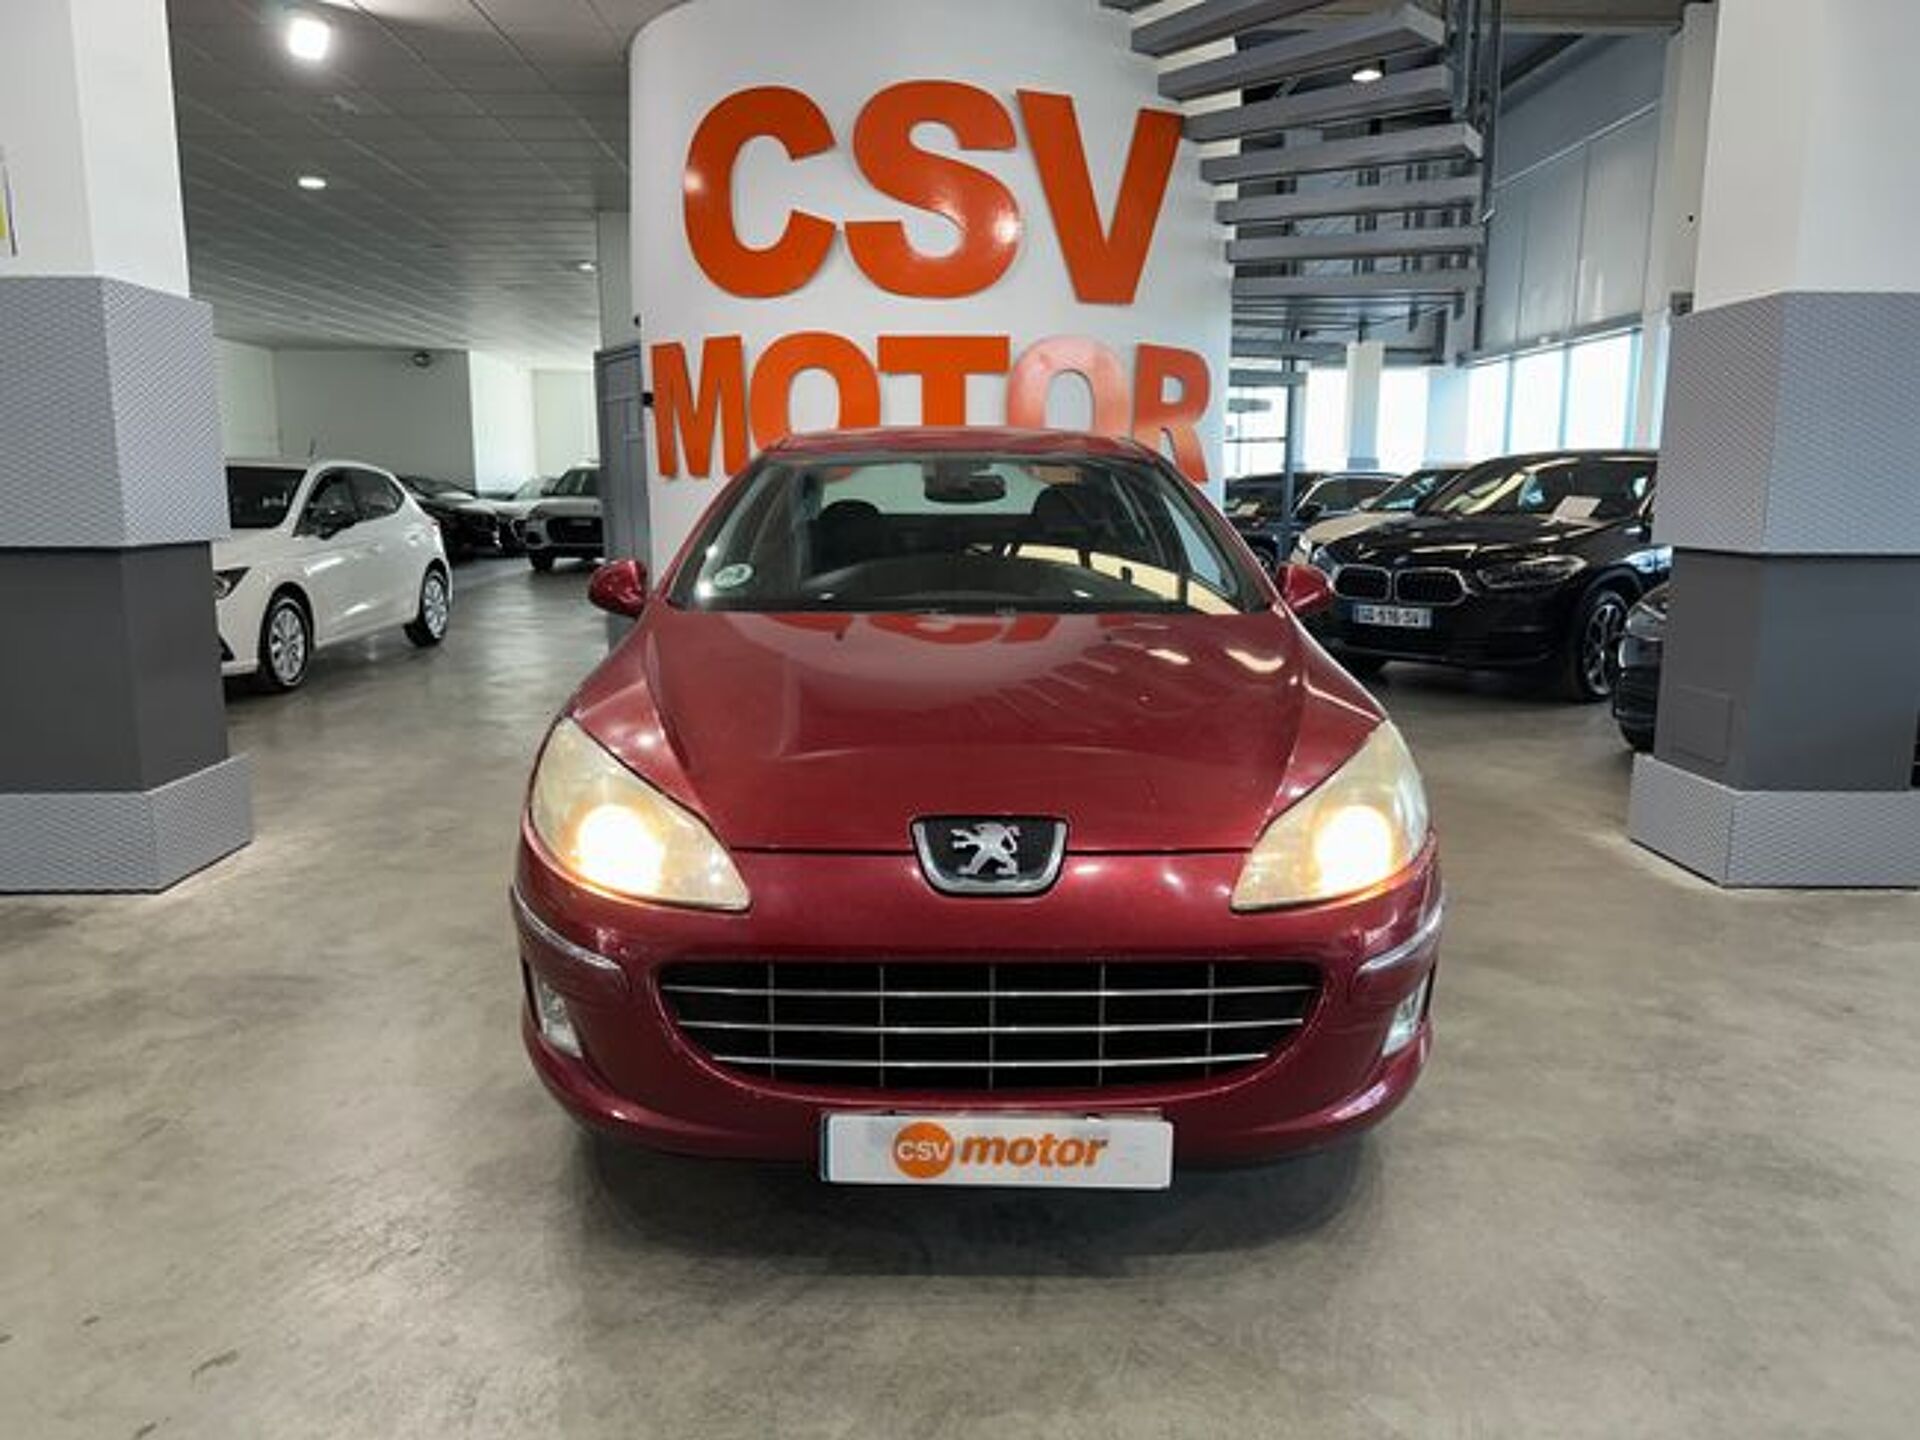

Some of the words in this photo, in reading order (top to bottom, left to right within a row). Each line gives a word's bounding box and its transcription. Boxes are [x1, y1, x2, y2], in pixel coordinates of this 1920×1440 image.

[683, 80, 1185, 305] CSV
[651, 331, 1210, 483] MOTOR
[959, 1133, 1109, 1168] motor
